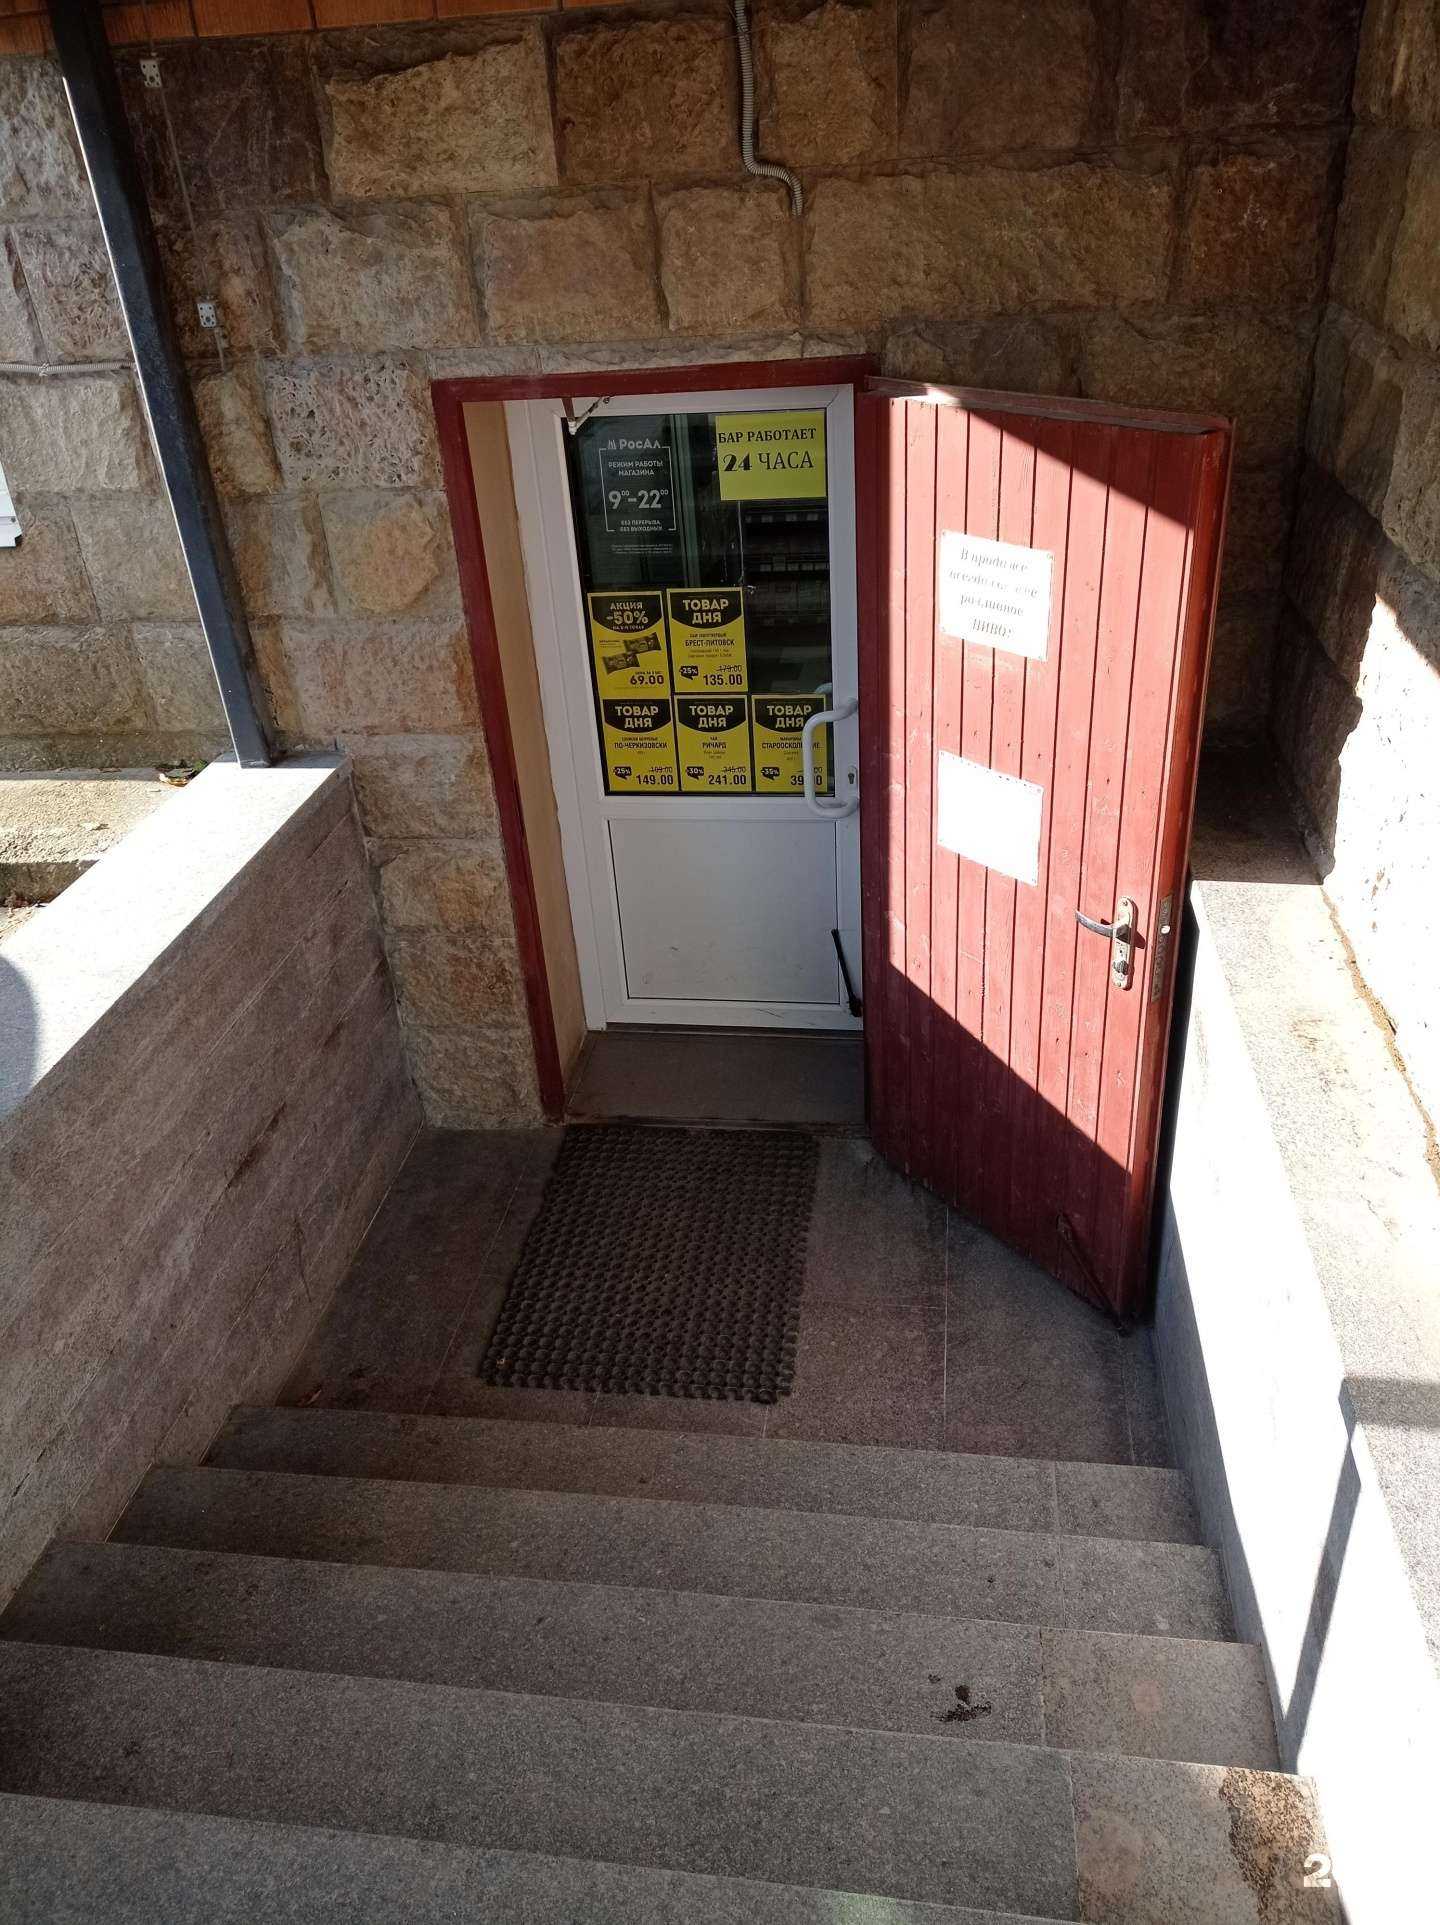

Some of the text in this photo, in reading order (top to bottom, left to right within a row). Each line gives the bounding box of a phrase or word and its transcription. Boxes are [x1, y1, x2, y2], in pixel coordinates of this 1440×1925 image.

[718, 428, 816, 443] БАР РАБОТАЕТ
[619, 439, 661, 450] РосАл
[722, 451, 813, 471] 24 ЧАСА
[610, 602, 643, 610] АКЦИЯ
[682, 599, 729, 611] ТОВАР
[606, 610, 649, 625] -50%
[692, 612, 722, 624] ДНЯ
[630, 675, 665, 685] 69.00
[703, 674, 743, 685] 135.00
[614, 706, 659, 716] ТОВАР
[689, 705, 734, 716] ТОВАР
[766, 705, 812, 716] ТОВАР
[624, 718, 652, 728] ДНЯ
[698, 718, 727, 728] ДНЯ
[775, 718, 804, 728] ДНЯ
[636, 775, 674, 785] 149.00
[708, 775, 747, 785] 241.00
